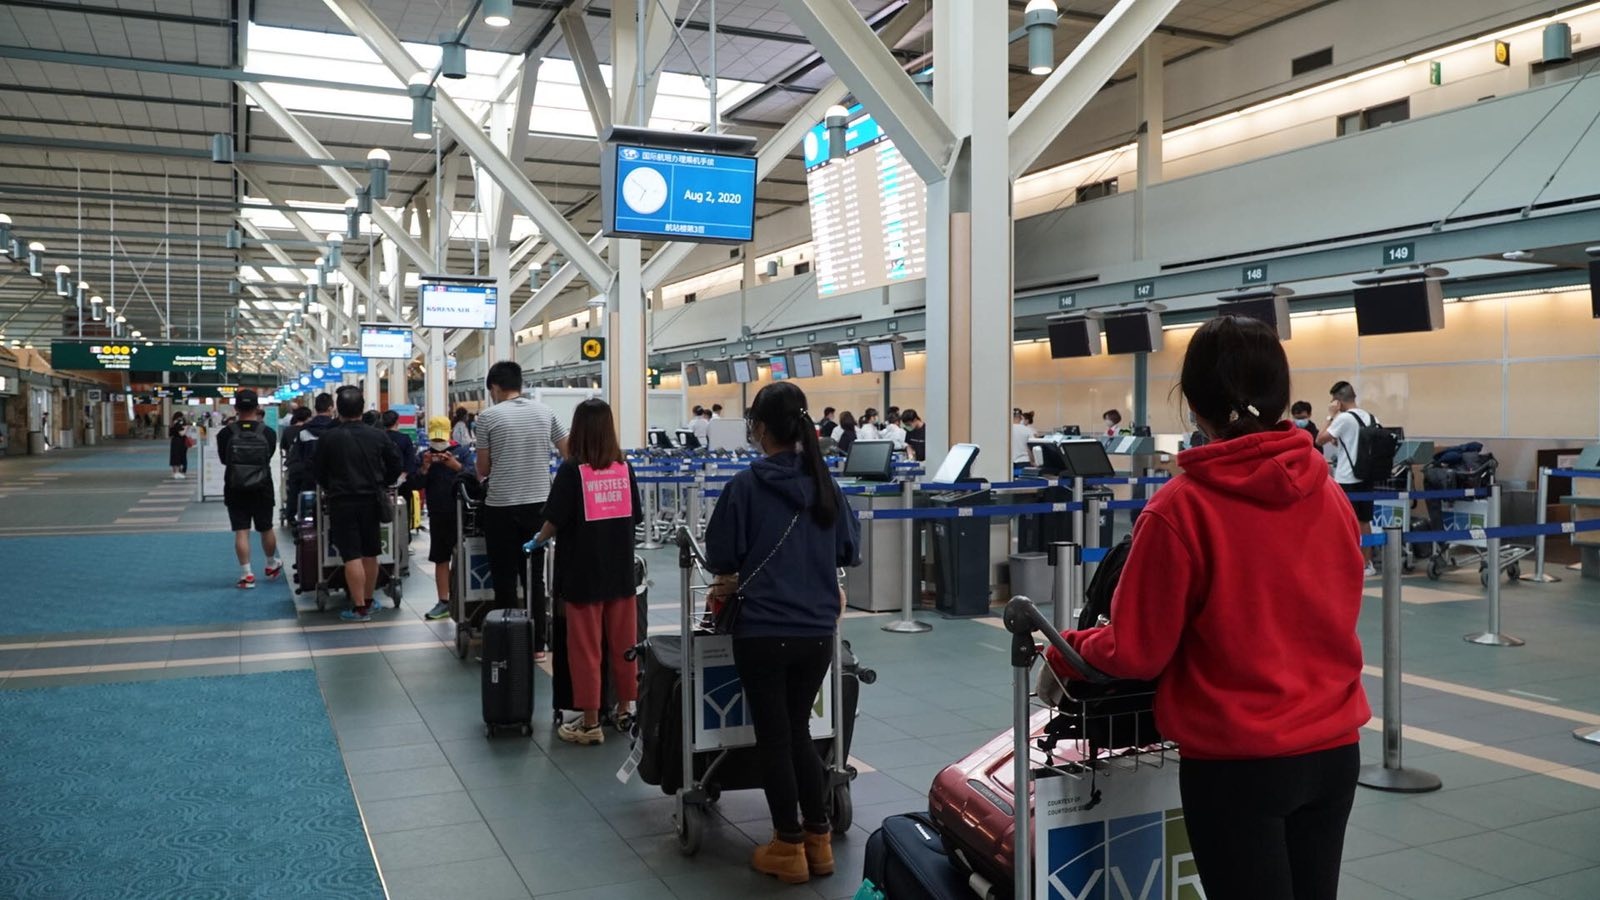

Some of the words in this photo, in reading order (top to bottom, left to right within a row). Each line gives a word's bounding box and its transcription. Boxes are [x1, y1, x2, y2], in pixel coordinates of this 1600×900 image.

[684, 190, 703, 203] Aug
[705, 191, 715, 203] 2,
[717, 192, 742, 204] 2020
[1389, 247, 1409, 260] 149
[1247, 269, 1262, 280] 148
[1137, 285, 1150, 296] 147
